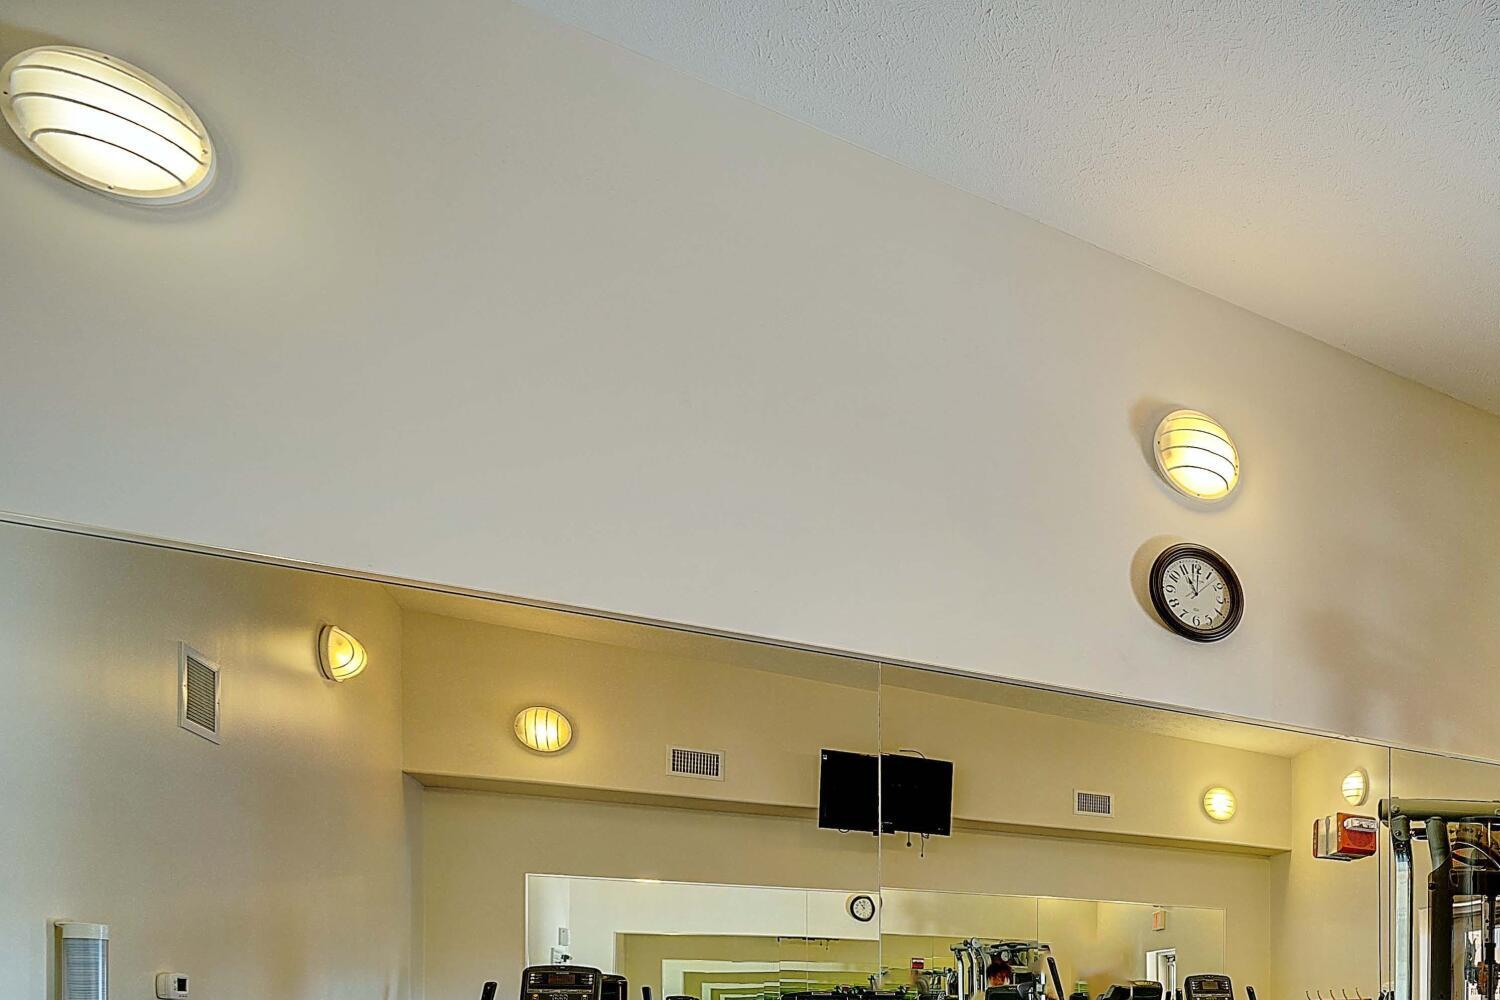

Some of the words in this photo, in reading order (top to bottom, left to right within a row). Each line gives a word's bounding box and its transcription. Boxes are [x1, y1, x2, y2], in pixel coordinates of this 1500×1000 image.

[1192, 564, 1202, 575] 12
[1169, 570, 1181, 583] 10
[1165, 584, 1176, 593] 9
[1169, 598, 1180, 608] 8
[1180, 609, 1189, 618] 7
[1192, 615, 1201, 626] 6
[1204, 615, 1213, 626] 5
